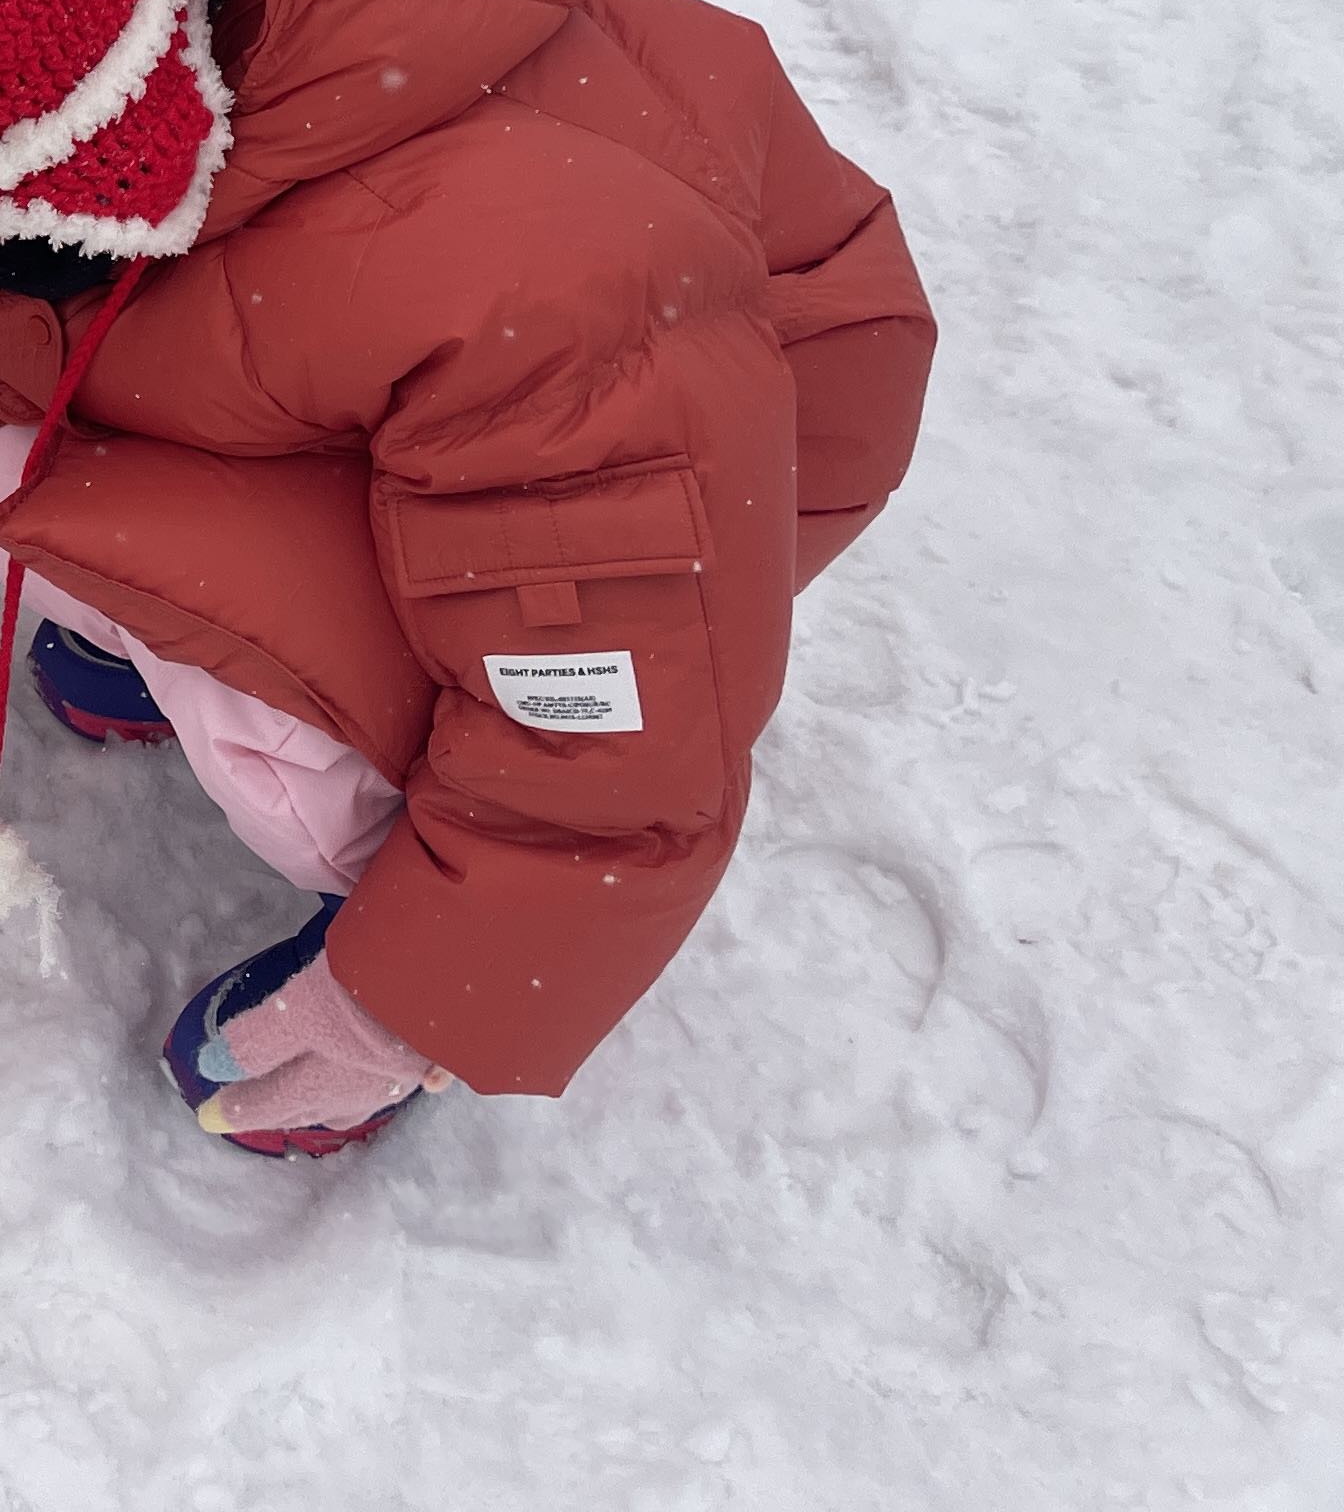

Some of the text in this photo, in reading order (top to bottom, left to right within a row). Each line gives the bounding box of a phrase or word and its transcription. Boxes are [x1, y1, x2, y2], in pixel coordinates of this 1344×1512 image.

[499, 667, 529, 677] EIGHT
[531, 668, 576, 677] PARTIES
[578, 667, 586, 676] &
